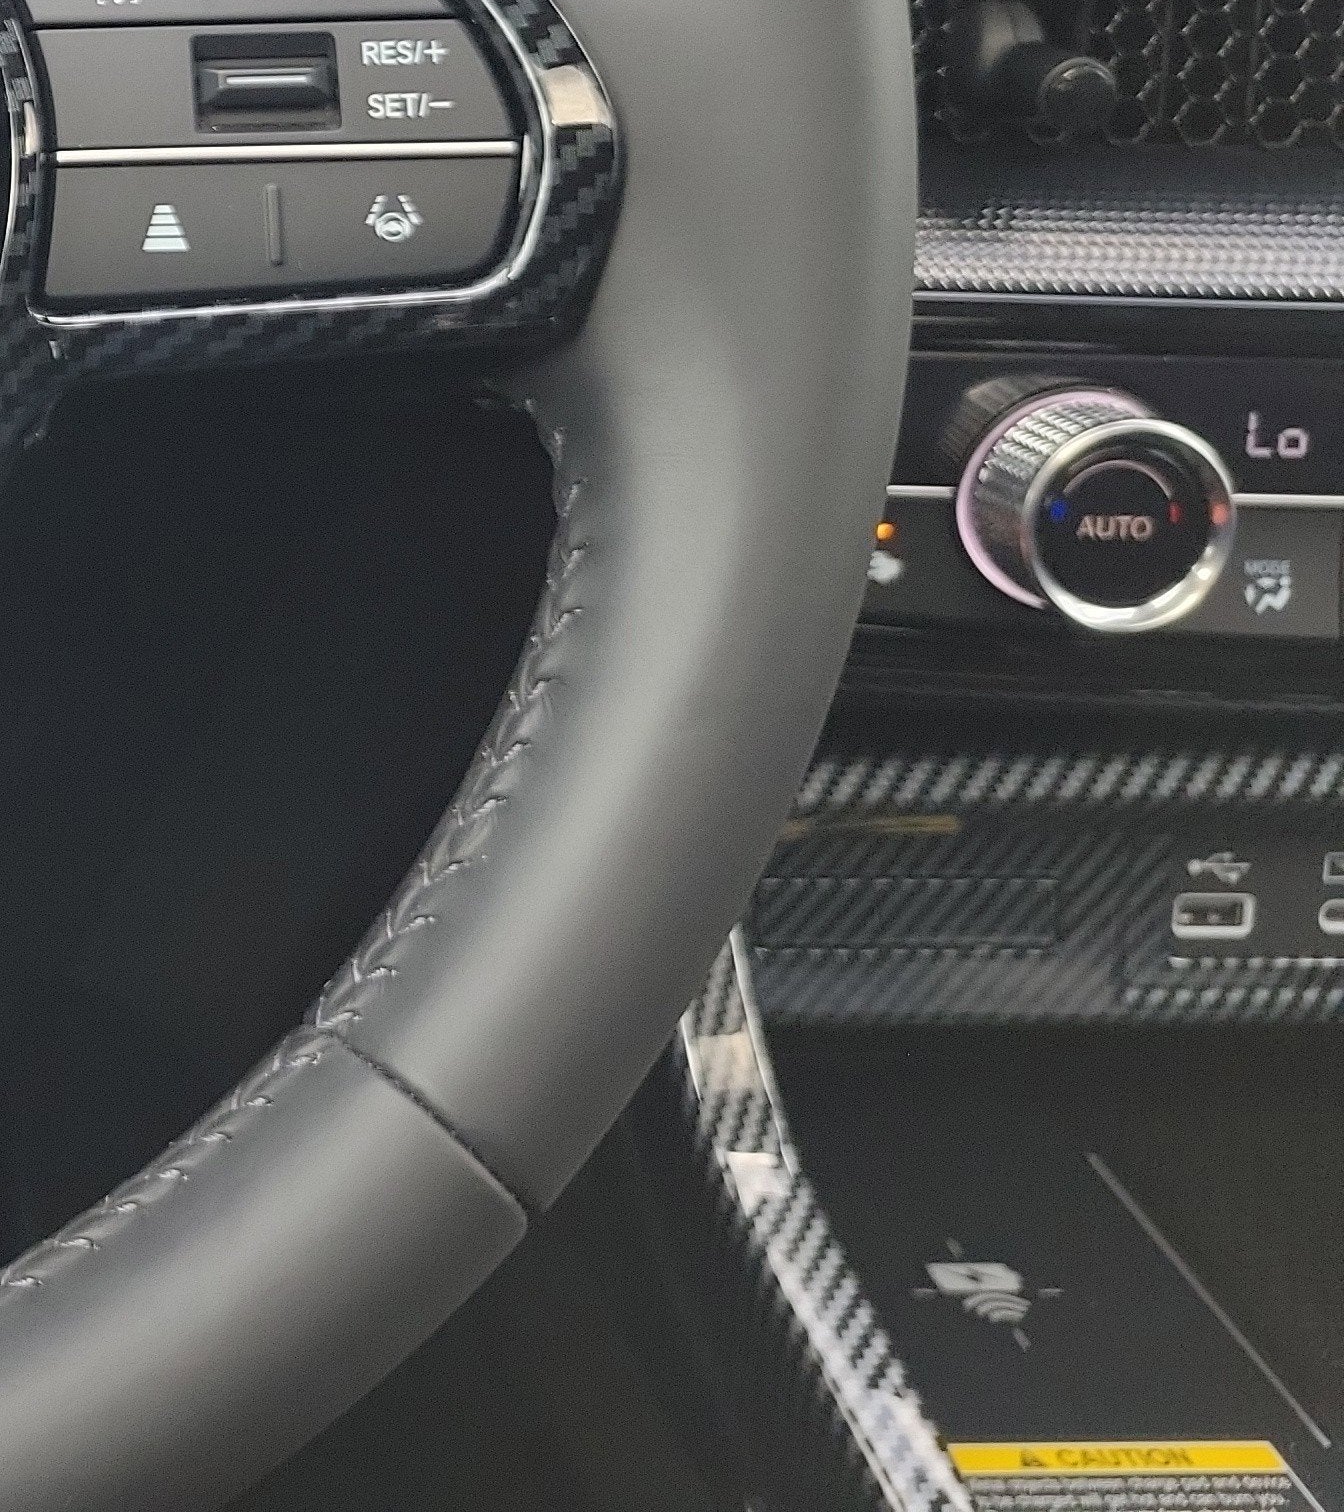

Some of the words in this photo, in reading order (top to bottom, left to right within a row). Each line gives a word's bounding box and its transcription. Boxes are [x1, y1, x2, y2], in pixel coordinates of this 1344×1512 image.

[361, 40, 449, 67] RES/+
[1245, 410, 1310, 459] Lo
[1076, 514, 1156, 542] AUTO
[1055, 1447, 1196, 1468] CAUTION
